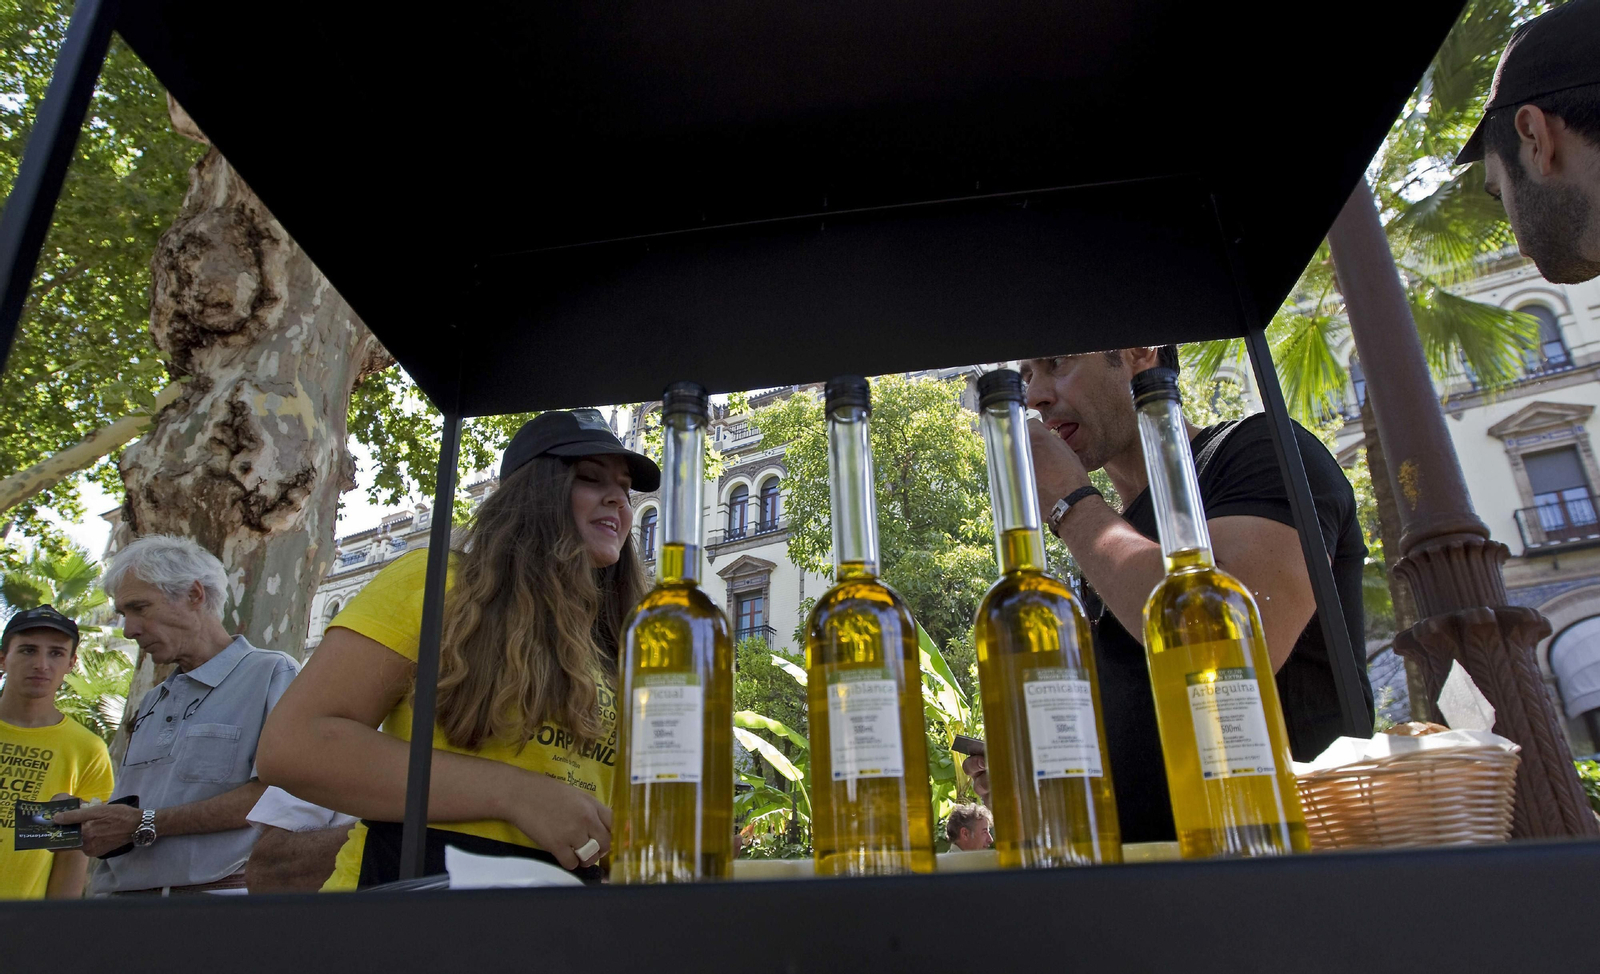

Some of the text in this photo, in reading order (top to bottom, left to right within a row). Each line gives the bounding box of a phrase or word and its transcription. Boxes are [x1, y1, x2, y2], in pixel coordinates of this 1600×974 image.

[1027, 684, 1089, 696] Cornicabra
[1192, 682, 1255, 698] Arbequina
[0, 755, 50, 771] VIRGEN
